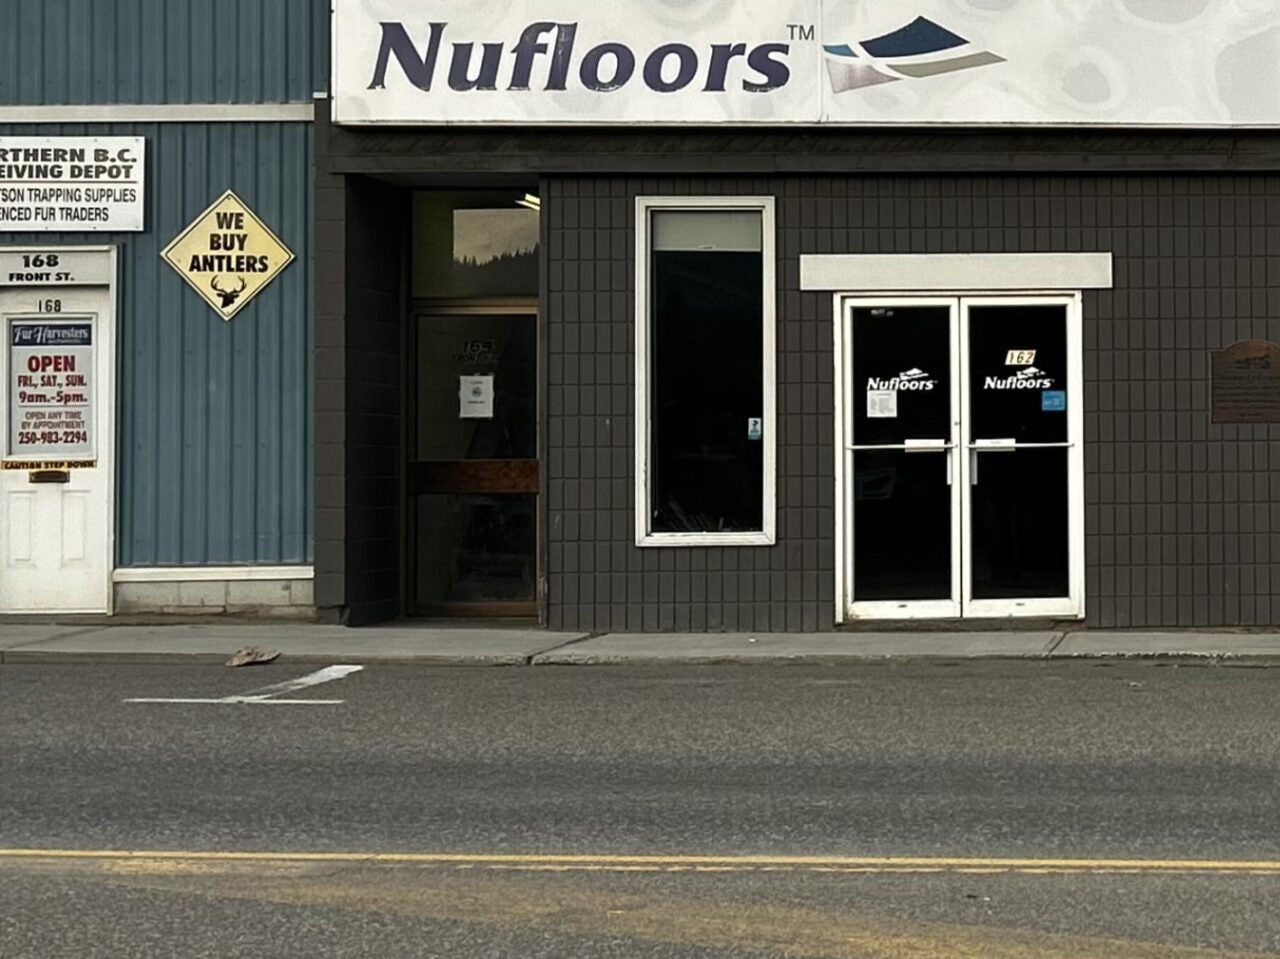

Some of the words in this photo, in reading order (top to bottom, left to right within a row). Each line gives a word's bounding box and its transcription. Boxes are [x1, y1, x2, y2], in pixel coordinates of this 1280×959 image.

[366, 21, 791, 93] Nufloors
[786, 24, 815, 41] TM
[93, 148, 137, 163] B.C.
[69, 164, 134, 179] DEPOT
[0, 188, 25, 203] SON
[27, 188, 82, 203] TRAPPING
[84, 188, 137, 203] SUPPLIES
[0, 206, 32, 222] NCED
[34, 206, 56, 222] FUR
[58, 206, 110, 222] TRADERS
[215, 211, 245, 230] WE
[209, 233, 249, 252] BUY
[22, 254, 60, 268] 168
[188, 255, 269, 273] ANTLERS
[8, 272, 52, 282] FRONT
[54, 272, 75, 282] ST.
[38, 299, 62, 313] 168
[33, 326, 88, 344] Harvesters
[27, 355, 76, 373] OPEN
[1009, 351, 1034, 363] 162
[866, 377, 935, 390] Nufloors
[984, 376, 1052, 389] Nufloors
[25, 411, 46, 420] OPEN
[21, 421, 32, 430] BY
[33, 420, 85, 430] APPOINTMENT
[4, 460, 42, 470] CAUTION
[44, 460, 65, 469] STEP
[66, 460, 95, 469] DOWN
